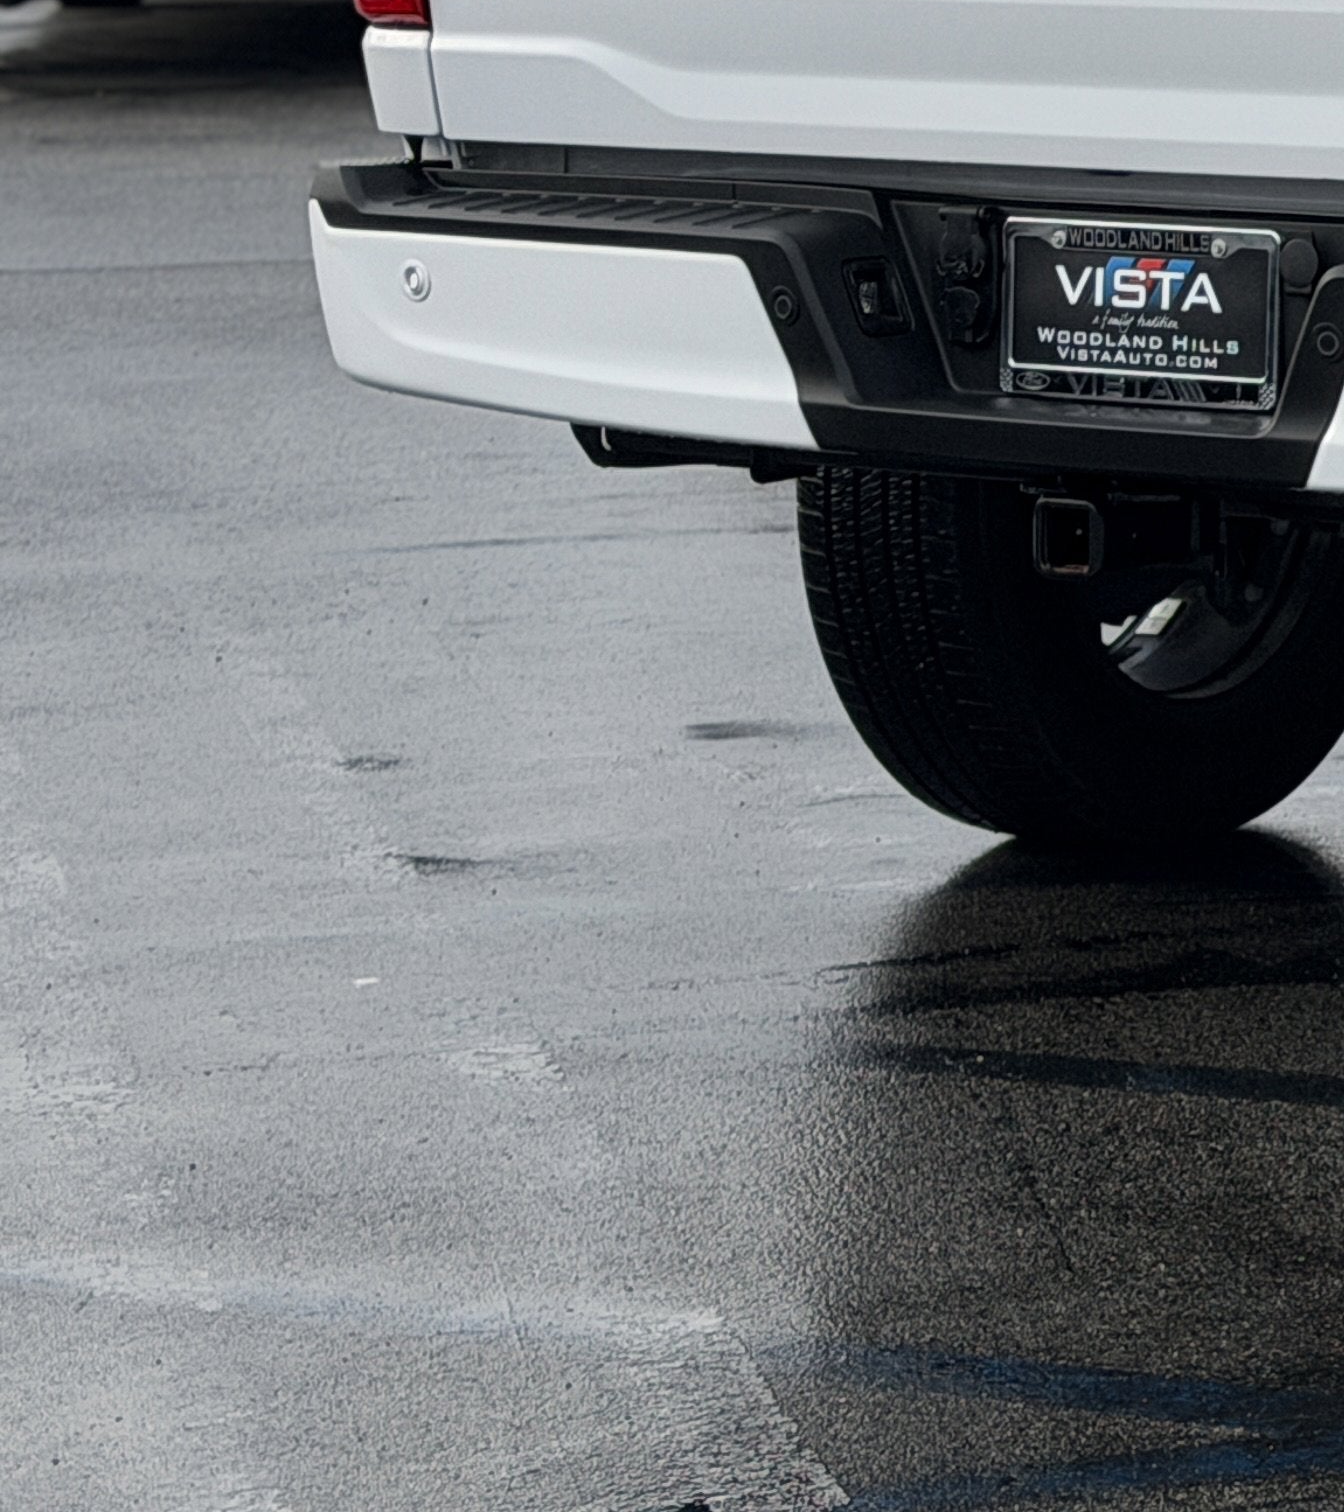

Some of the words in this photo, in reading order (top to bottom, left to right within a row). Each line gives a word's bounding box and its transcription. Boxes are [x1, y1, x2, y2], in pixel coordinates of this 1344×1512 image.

[1069, 228, 1162, 251] WOODLAND
[1164, 236, 1210, 252] HILLS
[1055, 264, 1223, 314] VISTA
[1037, 326, 1163, 350] WOODLAND
[1172, 335, 1239, 354] HILLS
